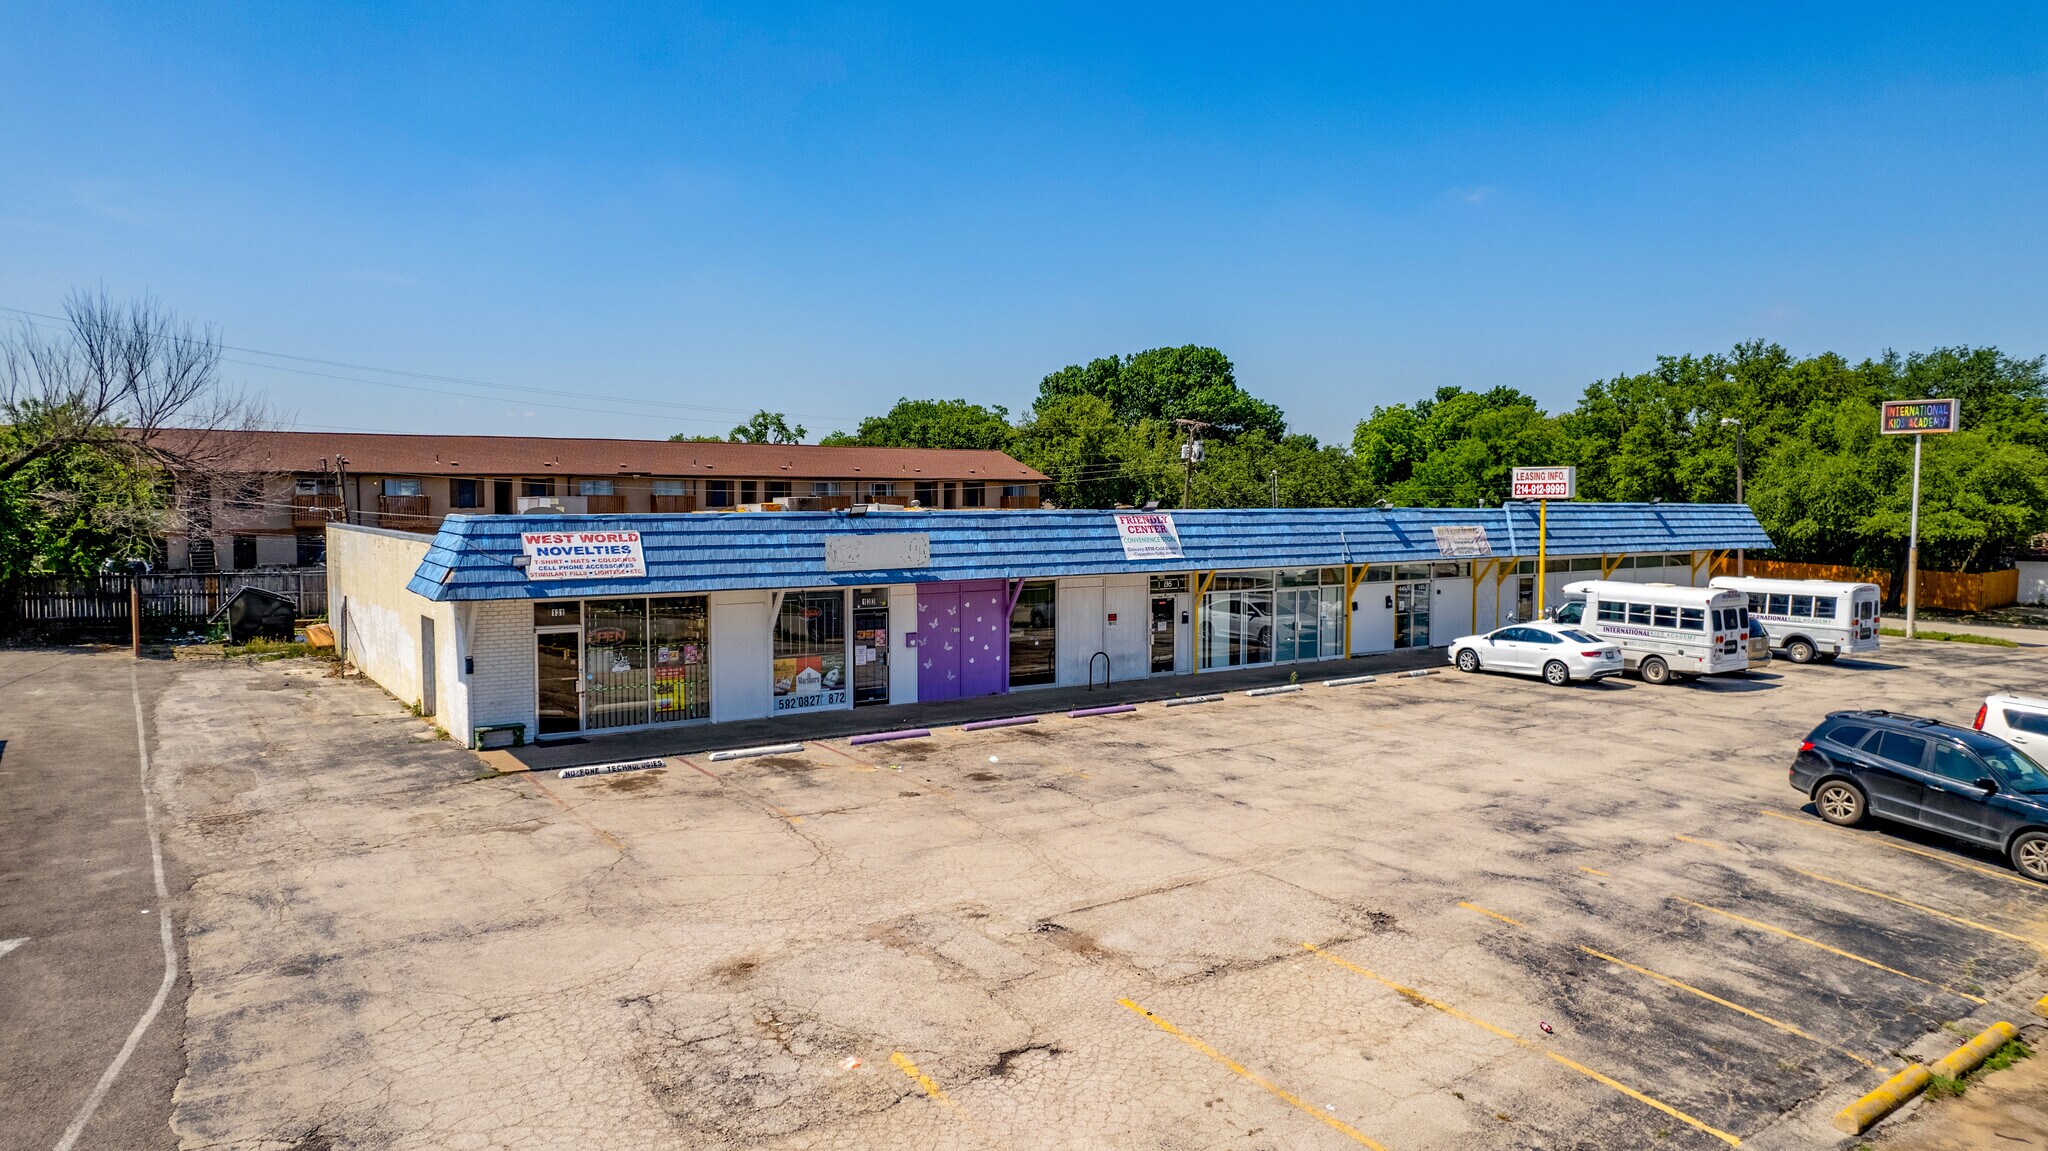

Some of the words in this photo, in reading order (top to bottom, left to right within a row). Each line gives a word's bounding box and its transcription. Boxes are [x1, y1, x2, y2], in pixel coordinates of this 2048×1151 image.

[1887, 404, 1949, 417] INTERNATIONAL
[1888, 418, 1905, 429] KIDS
[1908, 416, 1947, 428] ACADEMY
[1516, 472, 1546, 481] LEASING
[1547, 471, 1565, 481] INFO.
[1516, 483, 1565, 494] 214-912-9999
[1119, 515, 1168, 524] FRIENDLY
[1127, 525, 1168, 534] CENTER
[525, 534, 574, 544] WEST
[579, 533, 639, 543] WORLD
[1124, 536, 1161, 544] CONVENIENCE
[537, 545, 632, 557] NOVELTIES
[1603, 626, 1650, 637] INTERNATIONAL
[828, 692, 845, 703] 872
[607, 760, 663, 773] TECHNOLOGIES
